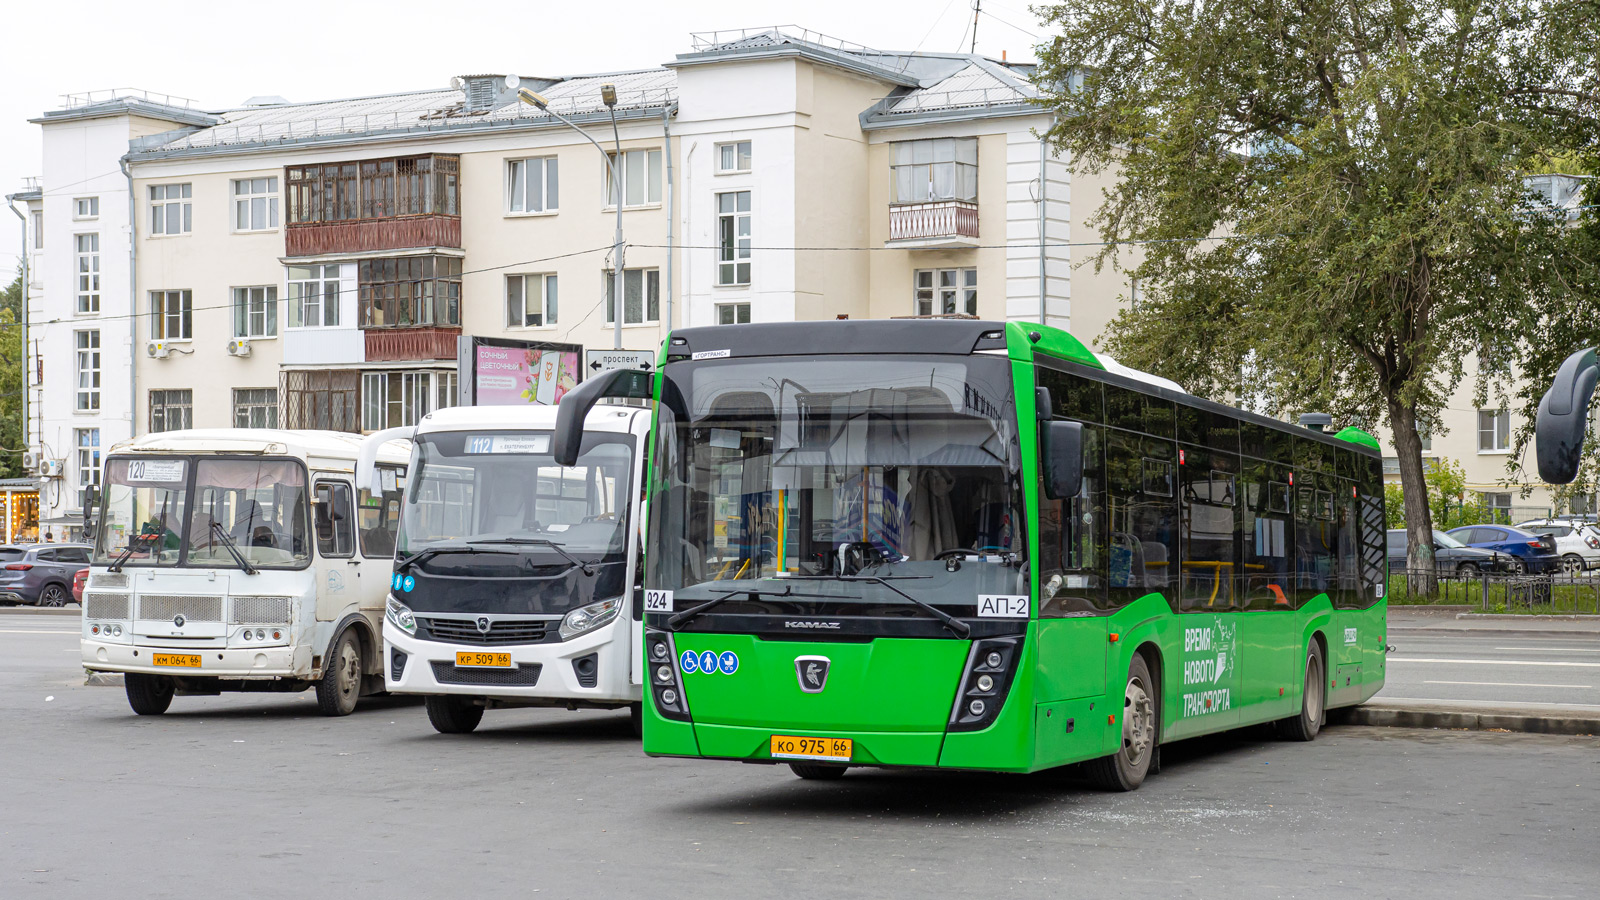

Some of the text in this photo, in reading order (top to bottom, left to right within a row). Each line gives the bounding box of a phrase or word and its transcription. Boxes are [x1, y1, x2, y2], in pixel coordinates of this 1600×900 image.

[480, 351, 508, 360] СОЧНЫЙ
[603, 356, 639, 364] проспект
[480, 361, 519, 371] ЦВЕТОЧНЫЙ
[473, 437, 491, 454] 112
[129, 461, 146, 479] 120
[647, 592, 667, 609] 924
[981, 597, 1026, 614] АП-2
[784, 621, 841, 629] KAMAZ
[1185, 627, 1211, 652] ВРЕМЯ
[170, 656, 186, 665] 064
[475, 654, 493, 665] 509
[498, 654, 508, 662] 66
[1184, 659, 1215, 685] НОВОГО
[1183, 688, 1230, 717] ТРАНСПОРТА
[799, 739, 825, 754] 975
[833, 740, 847, 752] 66
